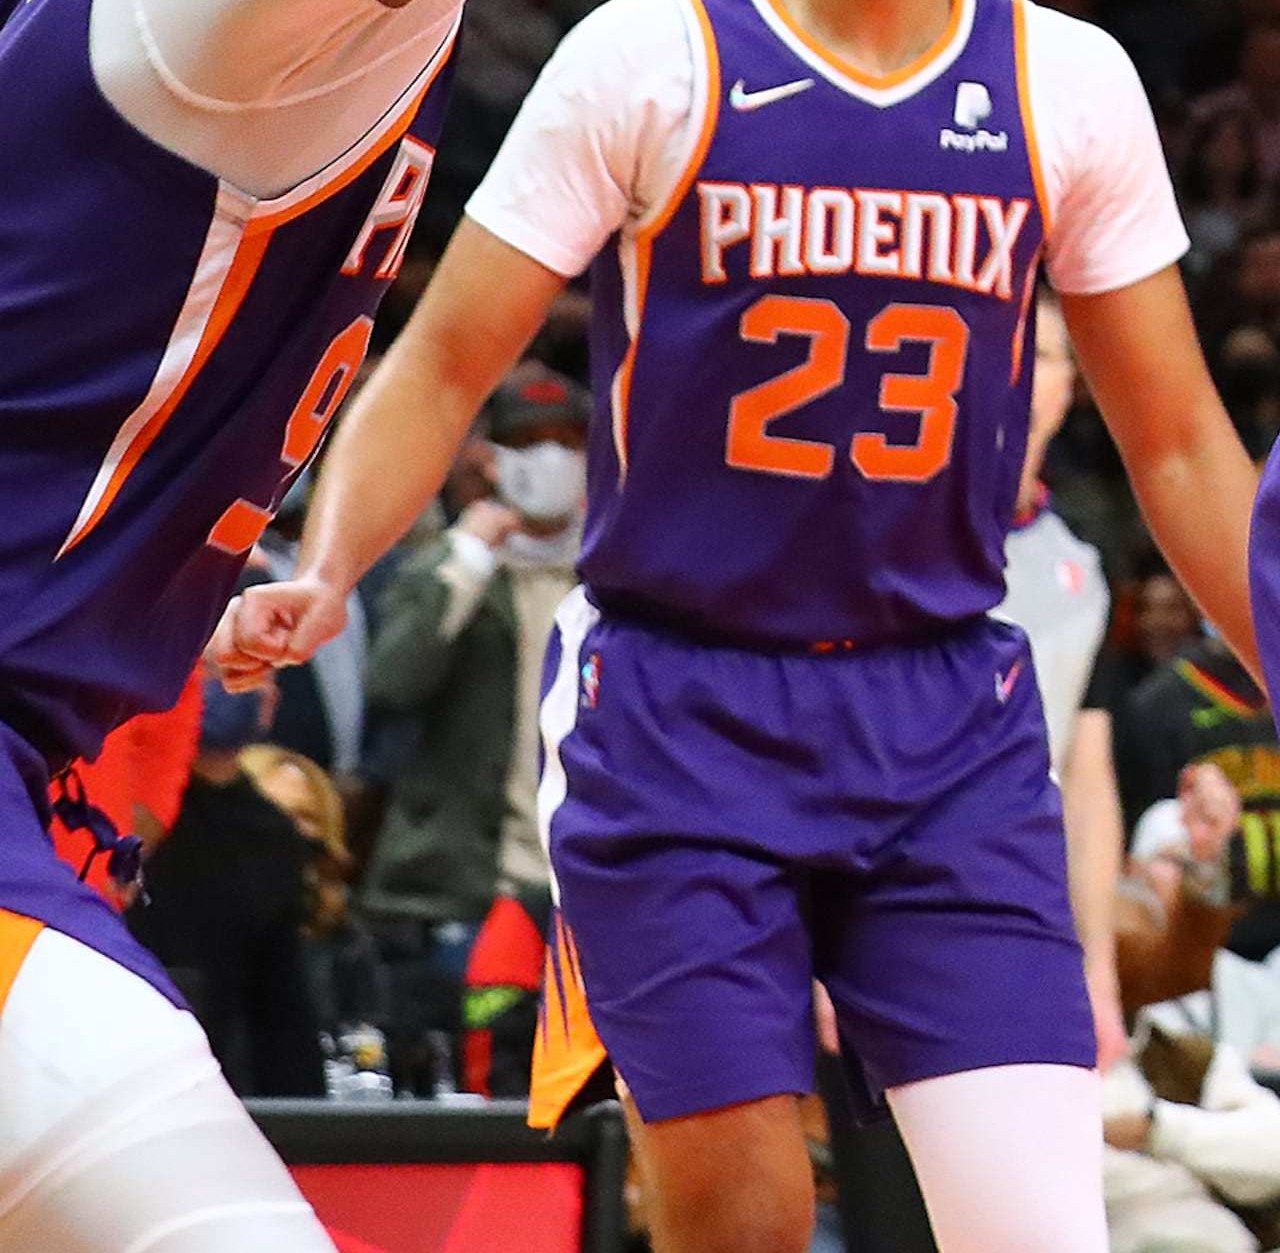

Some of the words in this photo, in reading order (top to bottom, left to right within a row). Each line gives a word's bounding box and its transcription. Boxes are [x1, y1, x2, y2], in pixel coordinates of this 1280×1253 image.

[940, 129, 1009, 154] PayPal
[697, 180, 1031, 300] PHOENIX
[725, 293, 970, 482] 23
